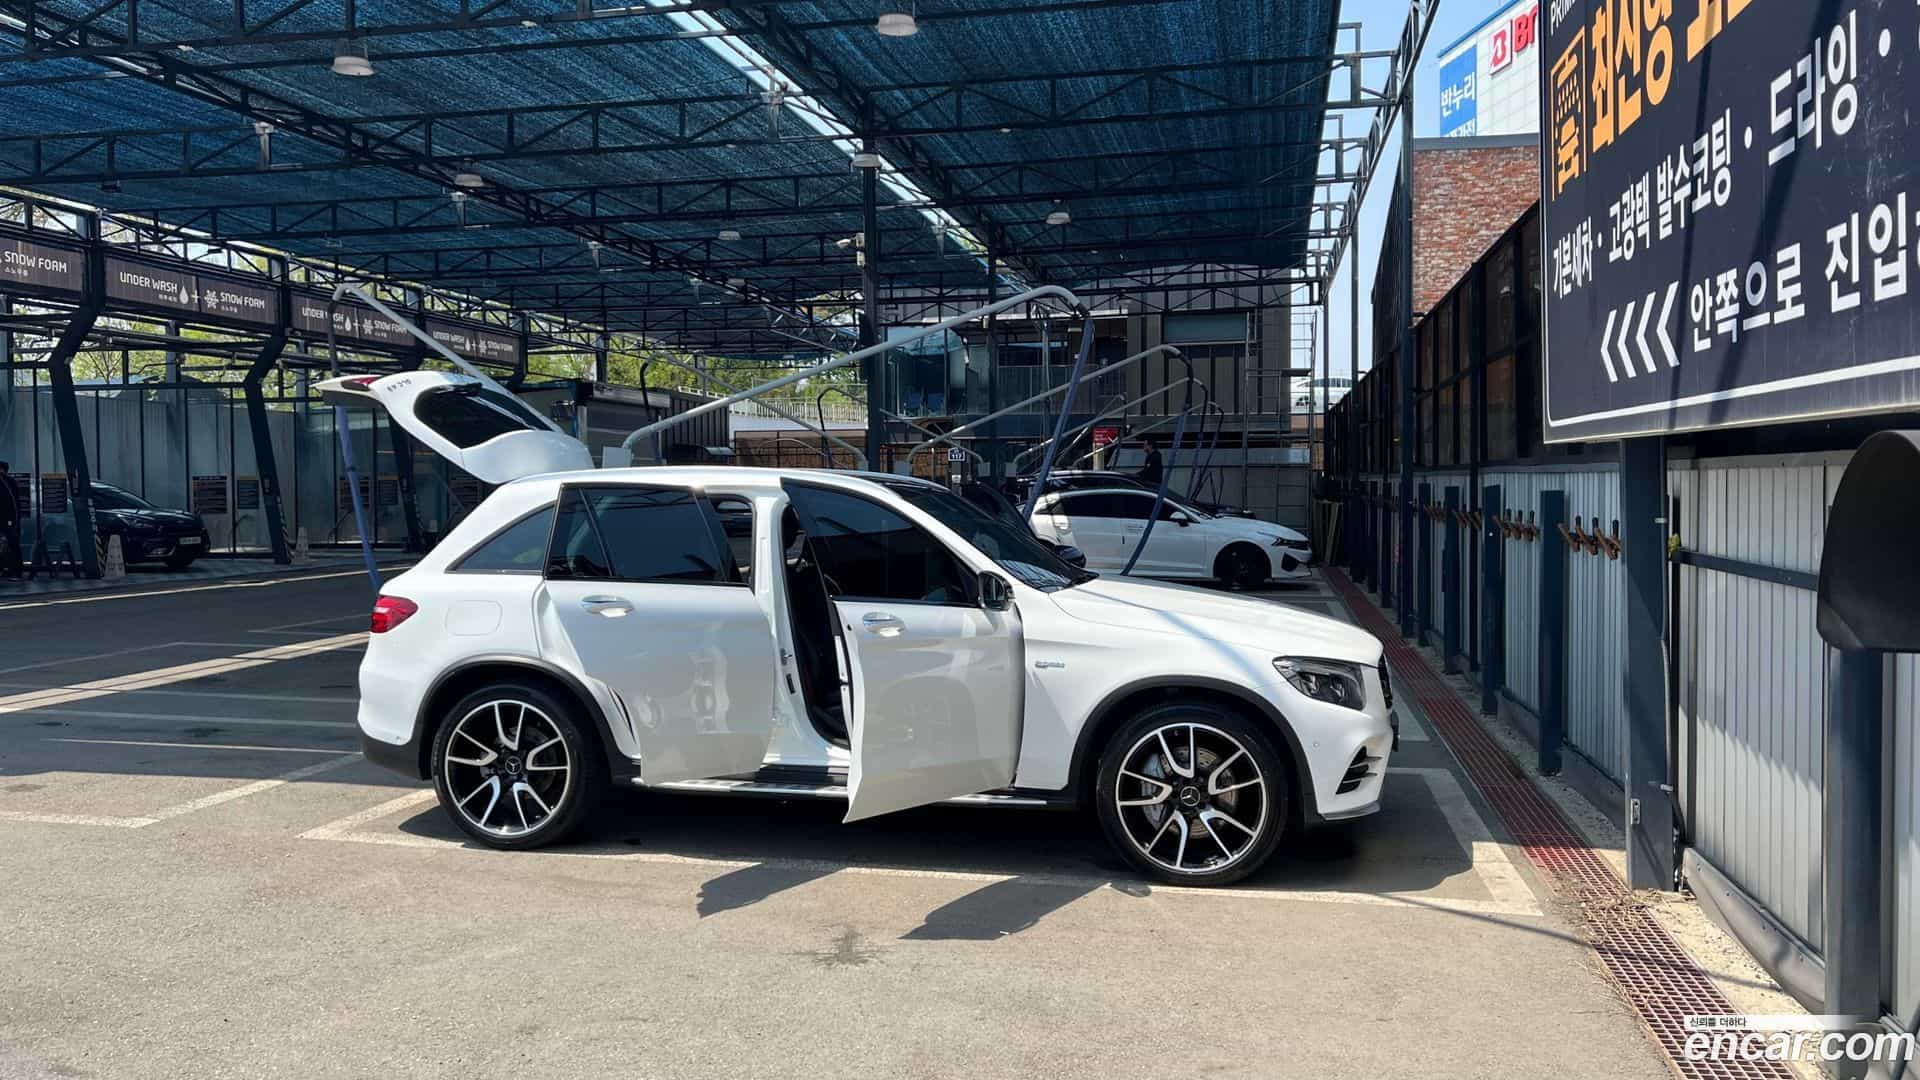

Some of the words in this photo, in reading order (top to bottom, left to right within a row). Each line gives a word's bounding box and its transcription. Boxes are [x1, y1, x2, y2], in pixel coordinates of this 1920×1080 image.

[1553, 216, 1593, 300] 기본세차
[1608, 171, 1650, 263] 고광택
[1657, 107, 1732, 240] 발수코팅
[1768, 8, 1858, 166] 드라잉
[4, 250, 36, 268] SNOW
[38, 257, 67, 273] FOAM
[119, 271, 151, 288] UNDER
[152, 279, 178, 293] WASH
[220, 291, 243, 305] SNOW
[244, 296, 265, 309] FOAM
[1690, 242, 1805, 353] 안쪽으로
[1825, 191, 1920, 313] 진입
